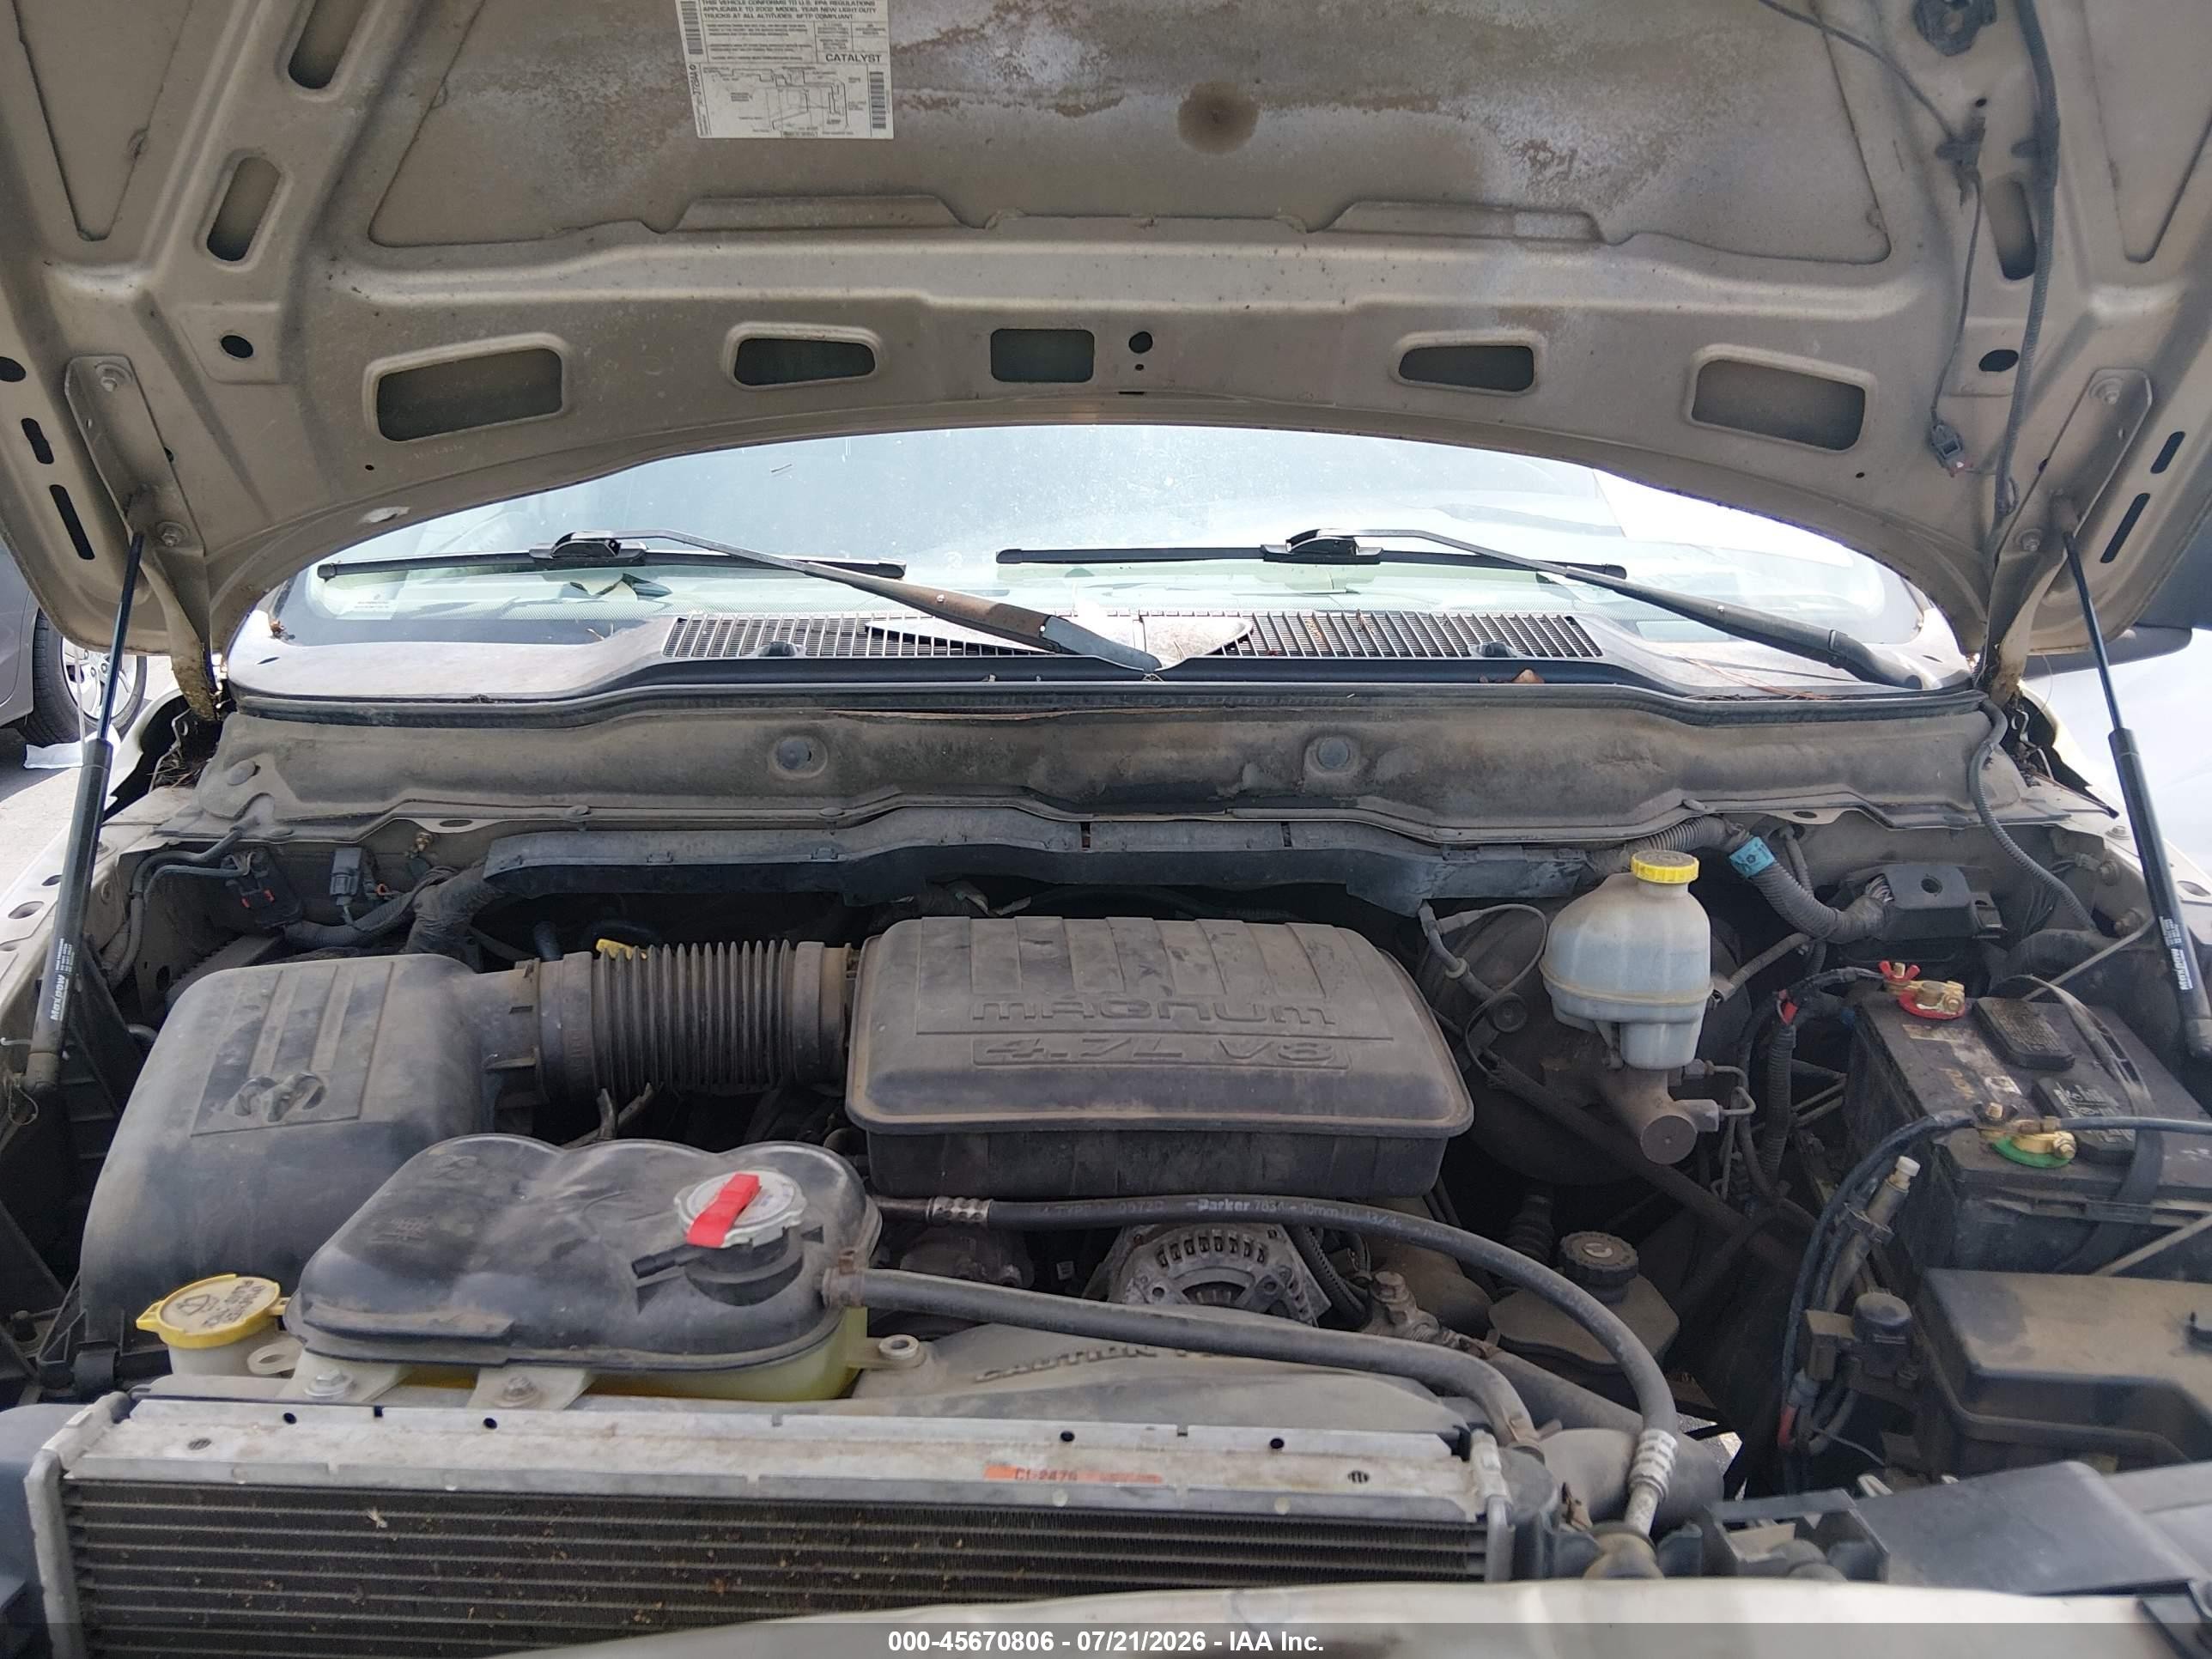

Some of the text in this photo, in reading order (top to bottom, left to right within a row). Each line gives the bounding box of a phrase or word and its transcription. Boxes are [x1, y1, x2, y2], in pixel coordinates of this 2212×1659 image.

[825, 53, 882, 63] CATALYST
[50, 974, 65, 1021] Maxpow
[1216, 1038, 1334, 1063] V8
[1198, 1198, 1251, 1212] Parker
